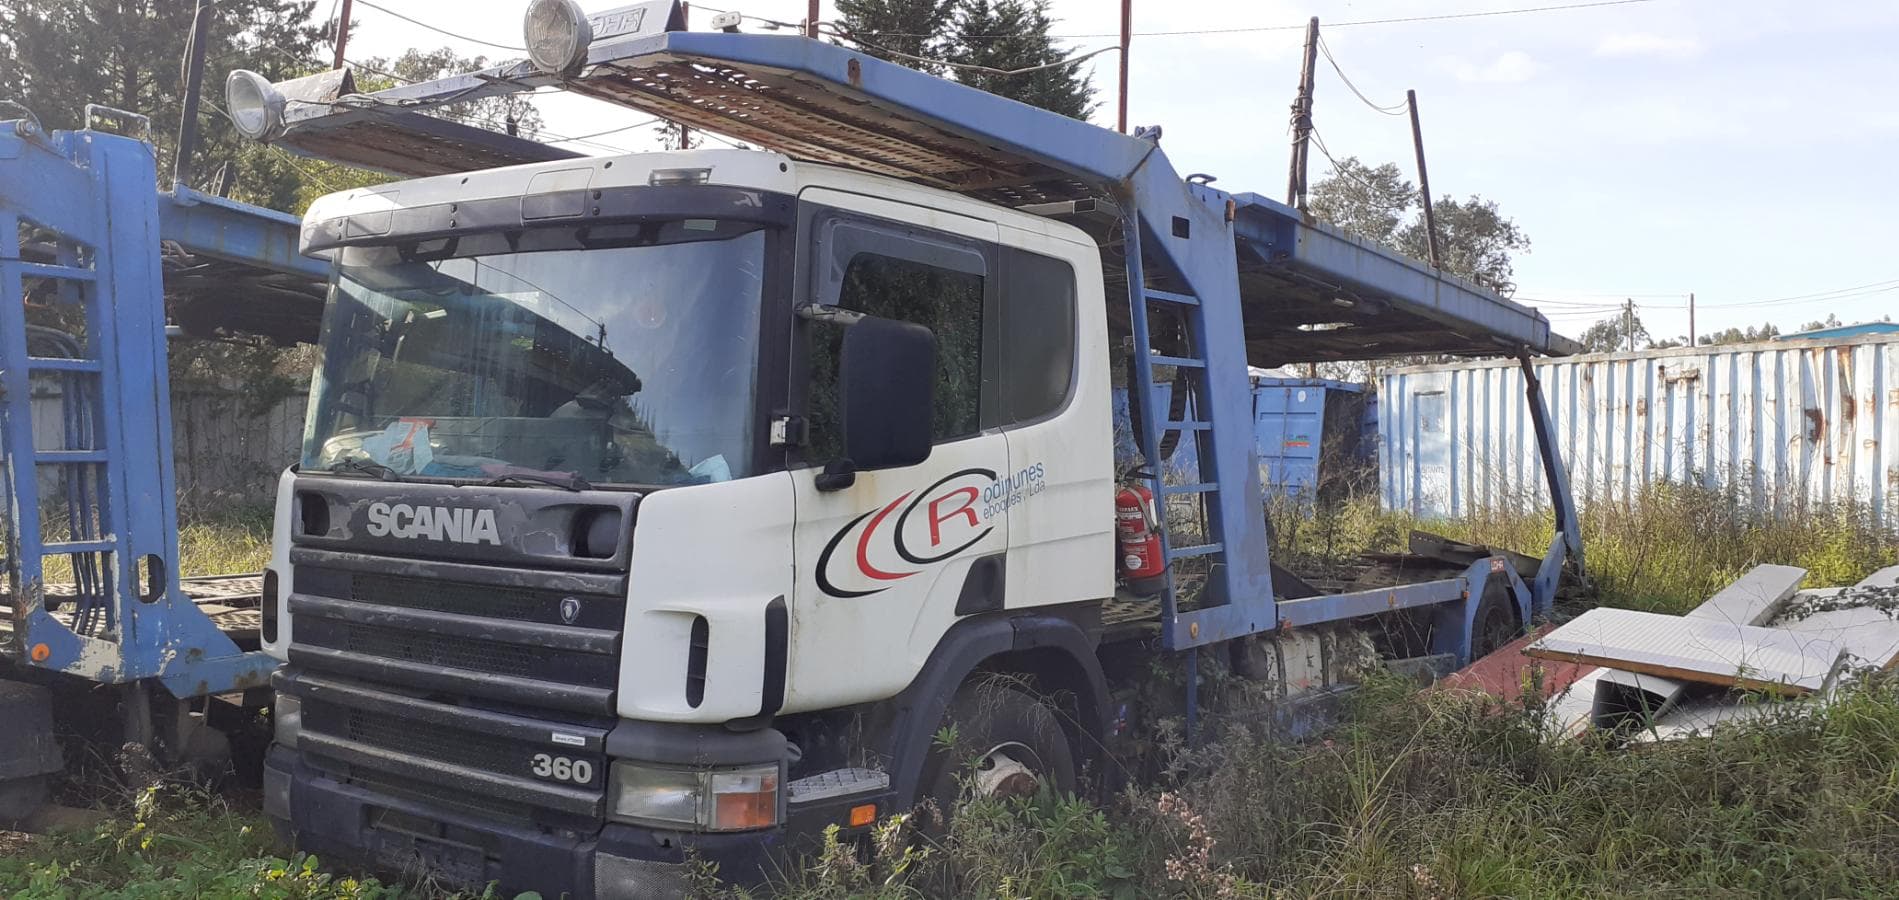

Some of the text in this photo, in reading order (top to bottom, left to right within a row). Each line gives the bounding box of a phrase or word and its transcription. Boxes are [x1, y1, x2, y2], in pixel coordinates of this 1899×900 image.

[1030, 480, 1045, 496] Lda
[366, 502, 501, 545] SCANIA
[929, 487, 979, 547] R
[533, 753, 592, 784] 360
